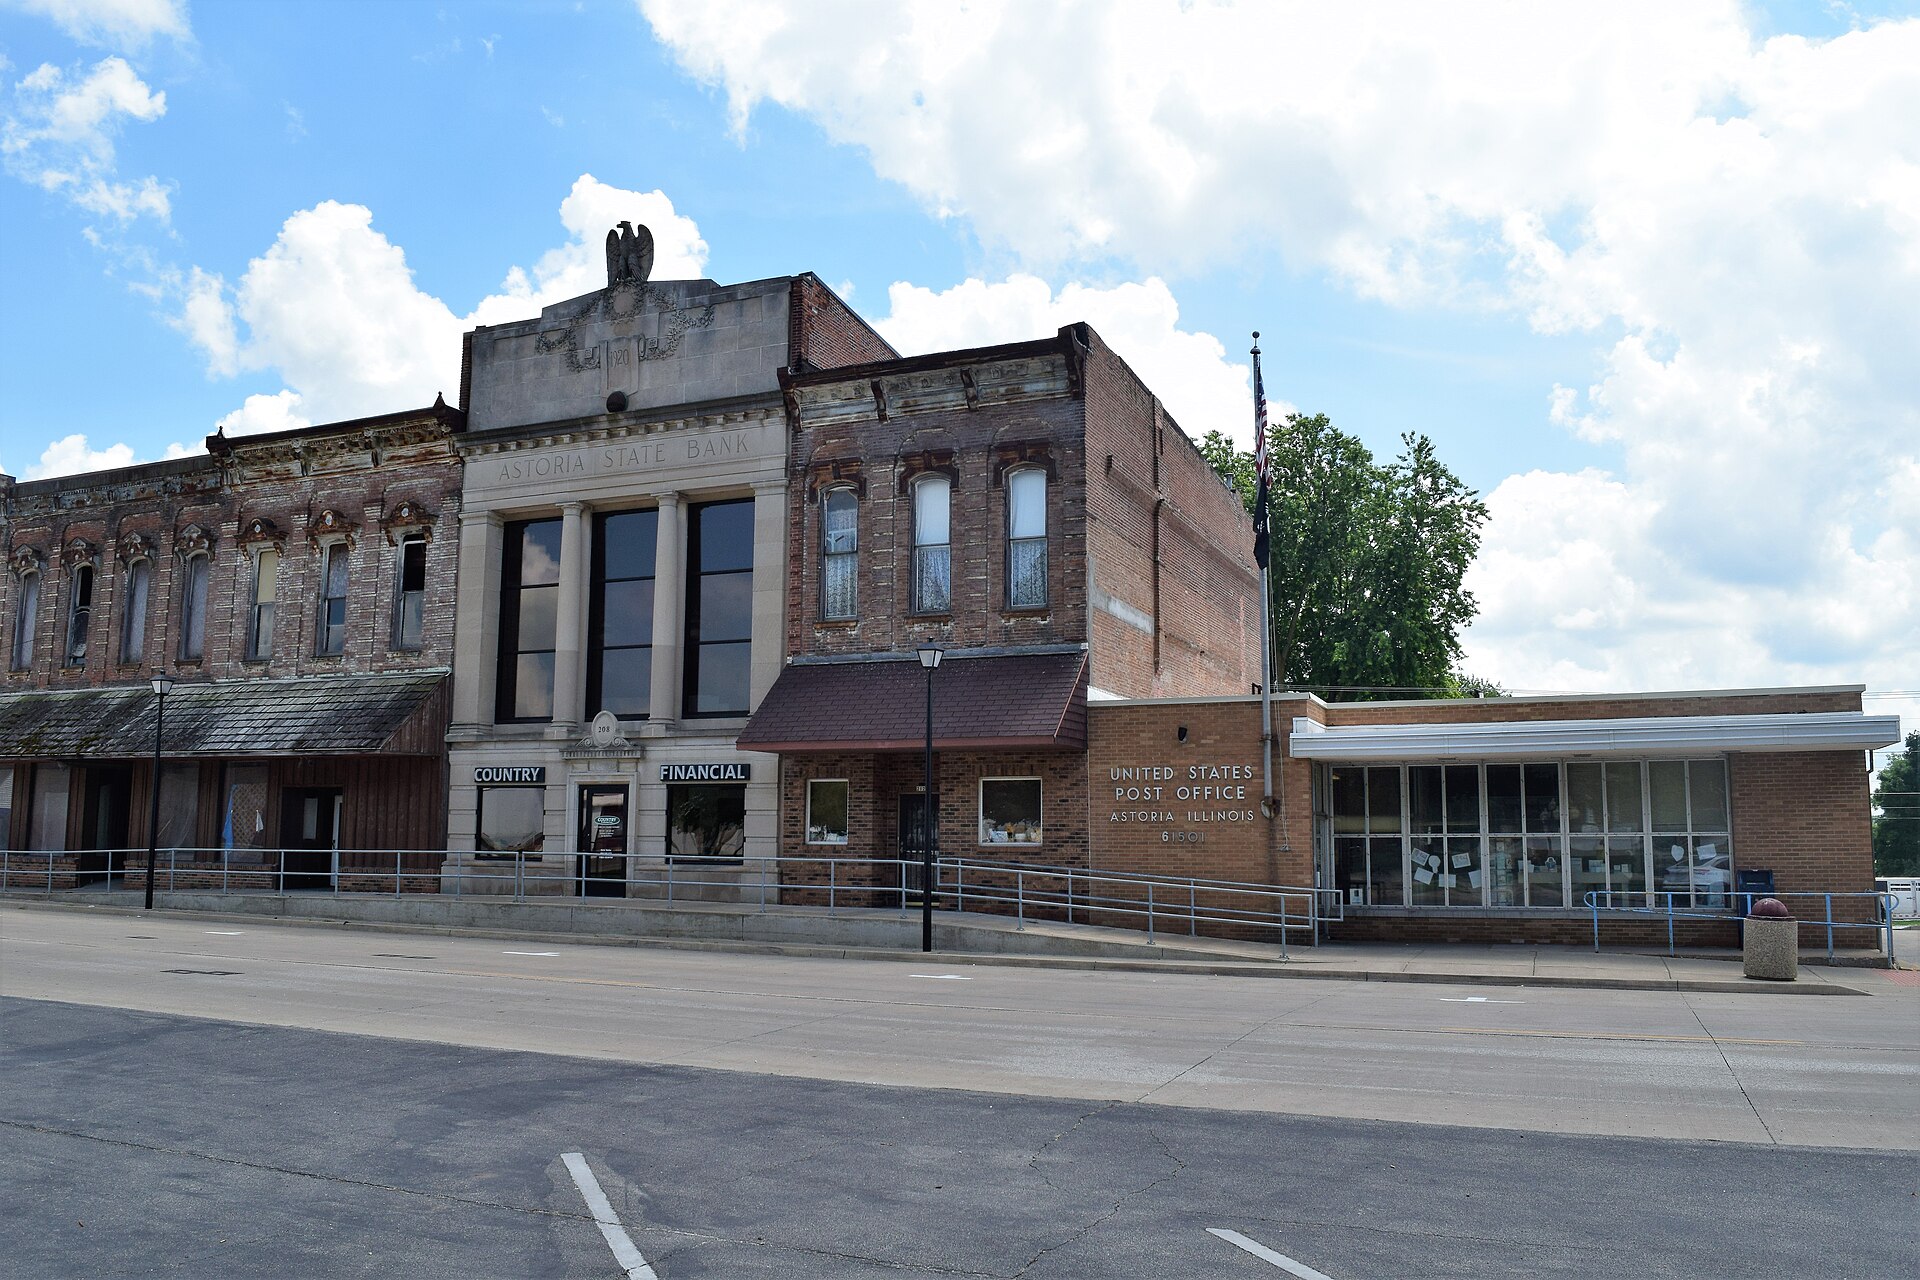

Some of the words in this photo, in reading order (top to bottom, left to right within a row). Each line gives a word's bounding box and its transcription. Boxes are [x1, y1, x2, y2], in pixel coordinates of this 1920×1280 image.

[610, 348, 630, 368] 1920
[498, 454, 585, 481] ASTORIA
[603, 443, 666, 468] STATE
[687, 432, 749, 459] BANK
[474, 767, 540, 783] COUNTRY
[660, 764, 746, 781] FINANCIAL
[1110, 767, 1174, 781] UNITED
[1188, 765, 1253, 780] STATES
[1115, 787, 1163, 801] POST
[1176, 786, 1246, 800] OFFICE
[1110, 811, 1175, 822] ASTORIA
[1187, 810, 1254, 822] ILLINOIS
[1161, 831, 1205, 842] 61501
